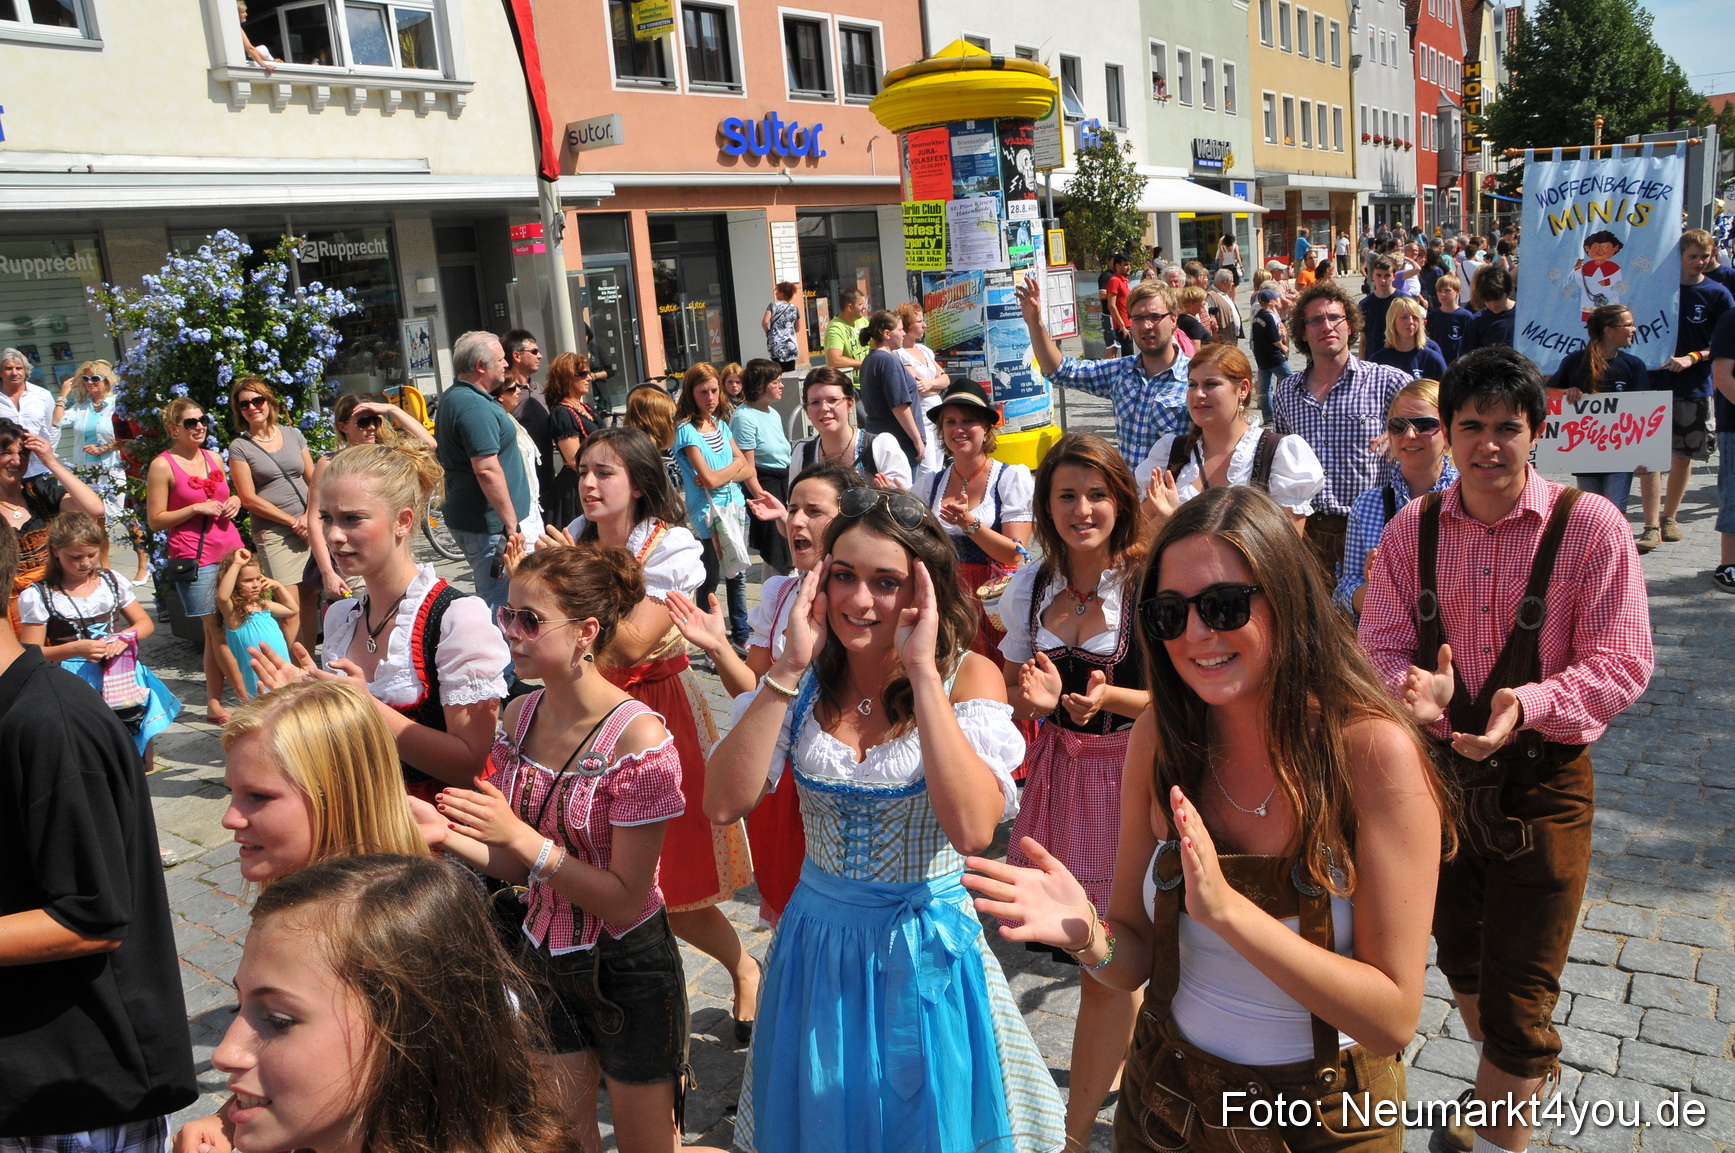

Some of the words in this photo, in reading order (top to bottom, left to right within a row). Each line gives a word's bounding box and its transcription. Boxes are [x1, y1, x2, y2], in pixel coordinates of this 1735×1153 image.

[1465, 63, 1481, 152] HOTEL
[568, 123, 613, 146] sutor.
[722, 110, 827, 158] sutor.
[911, 155, 949, 165] VOLKSFEST
[917, 148, 938, 156] JURA-
[1535, 175, 1673, 208] WOFFENBACHER
[922, 203, 942, 215] Club
[1548, 199, 1654, 236] MINIS
[318, 239, 388, 261] Rupprecht
[0, 252, 95, 280] Rupprecht
[1000, 310, 1022, 318] Zeltevange
[1622, 309, 1671, 350] MPF!
[1546, 397, 1563, 416] N
[1573, 397, 1619, 415] VON
[539, 844, 550, 861] 2011
